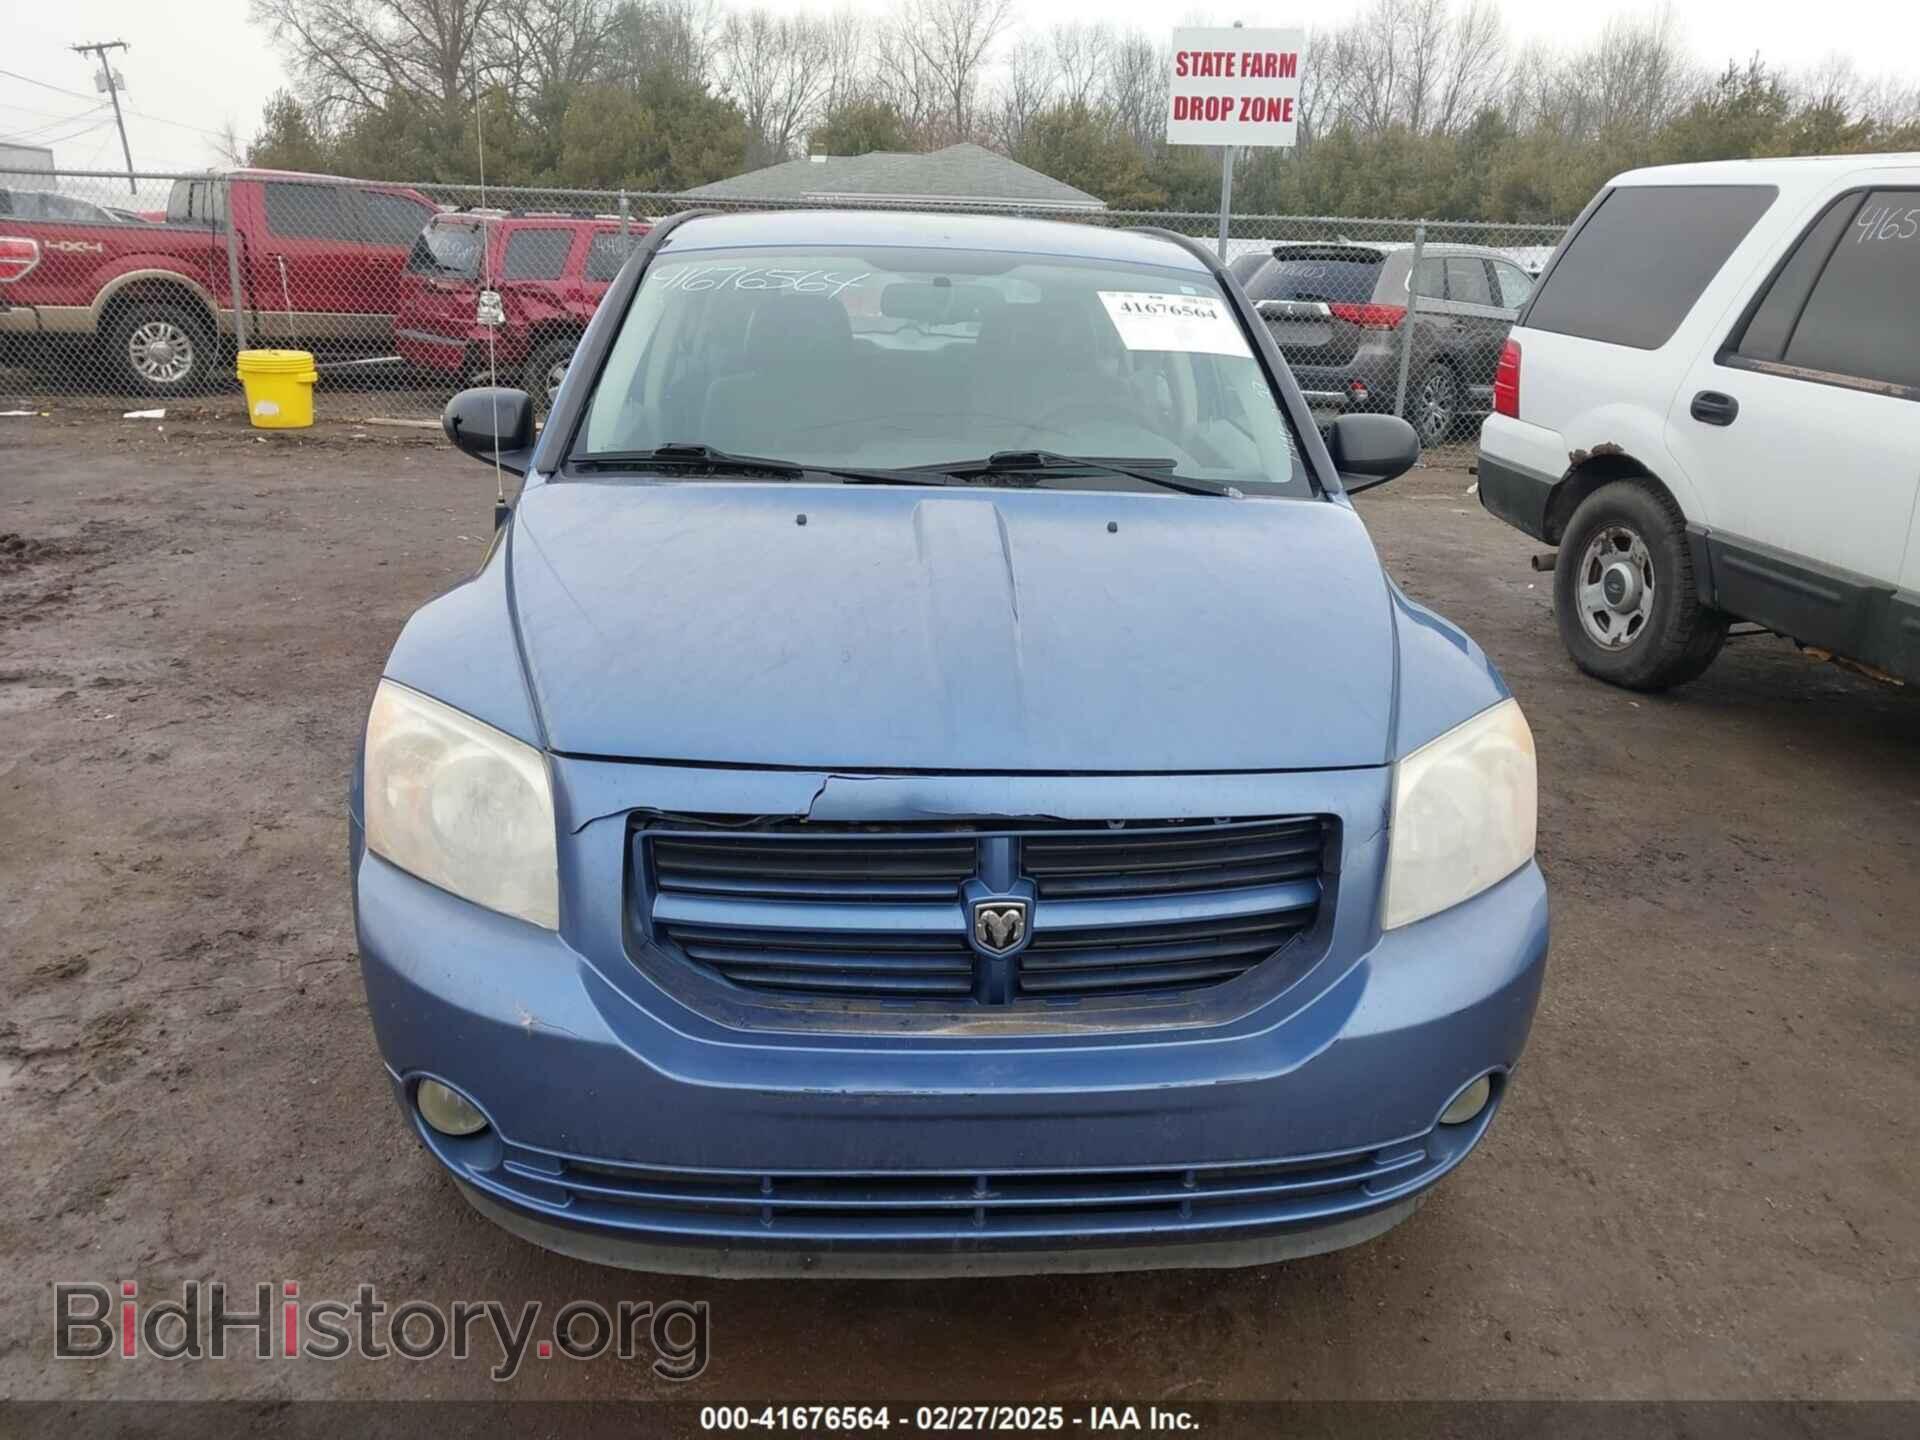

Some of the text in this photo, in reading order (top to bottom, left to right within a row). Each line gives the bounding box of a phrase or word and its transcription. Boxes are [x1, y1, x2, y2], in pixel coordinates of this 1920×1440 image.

[1175, 51, 1298, 79] STATE FARM
[1173, 95, 1295, 123] DROP ZONE
[651, 265, 871, 300] 41676564
[1120, 301, 1218, 320] 41676564
